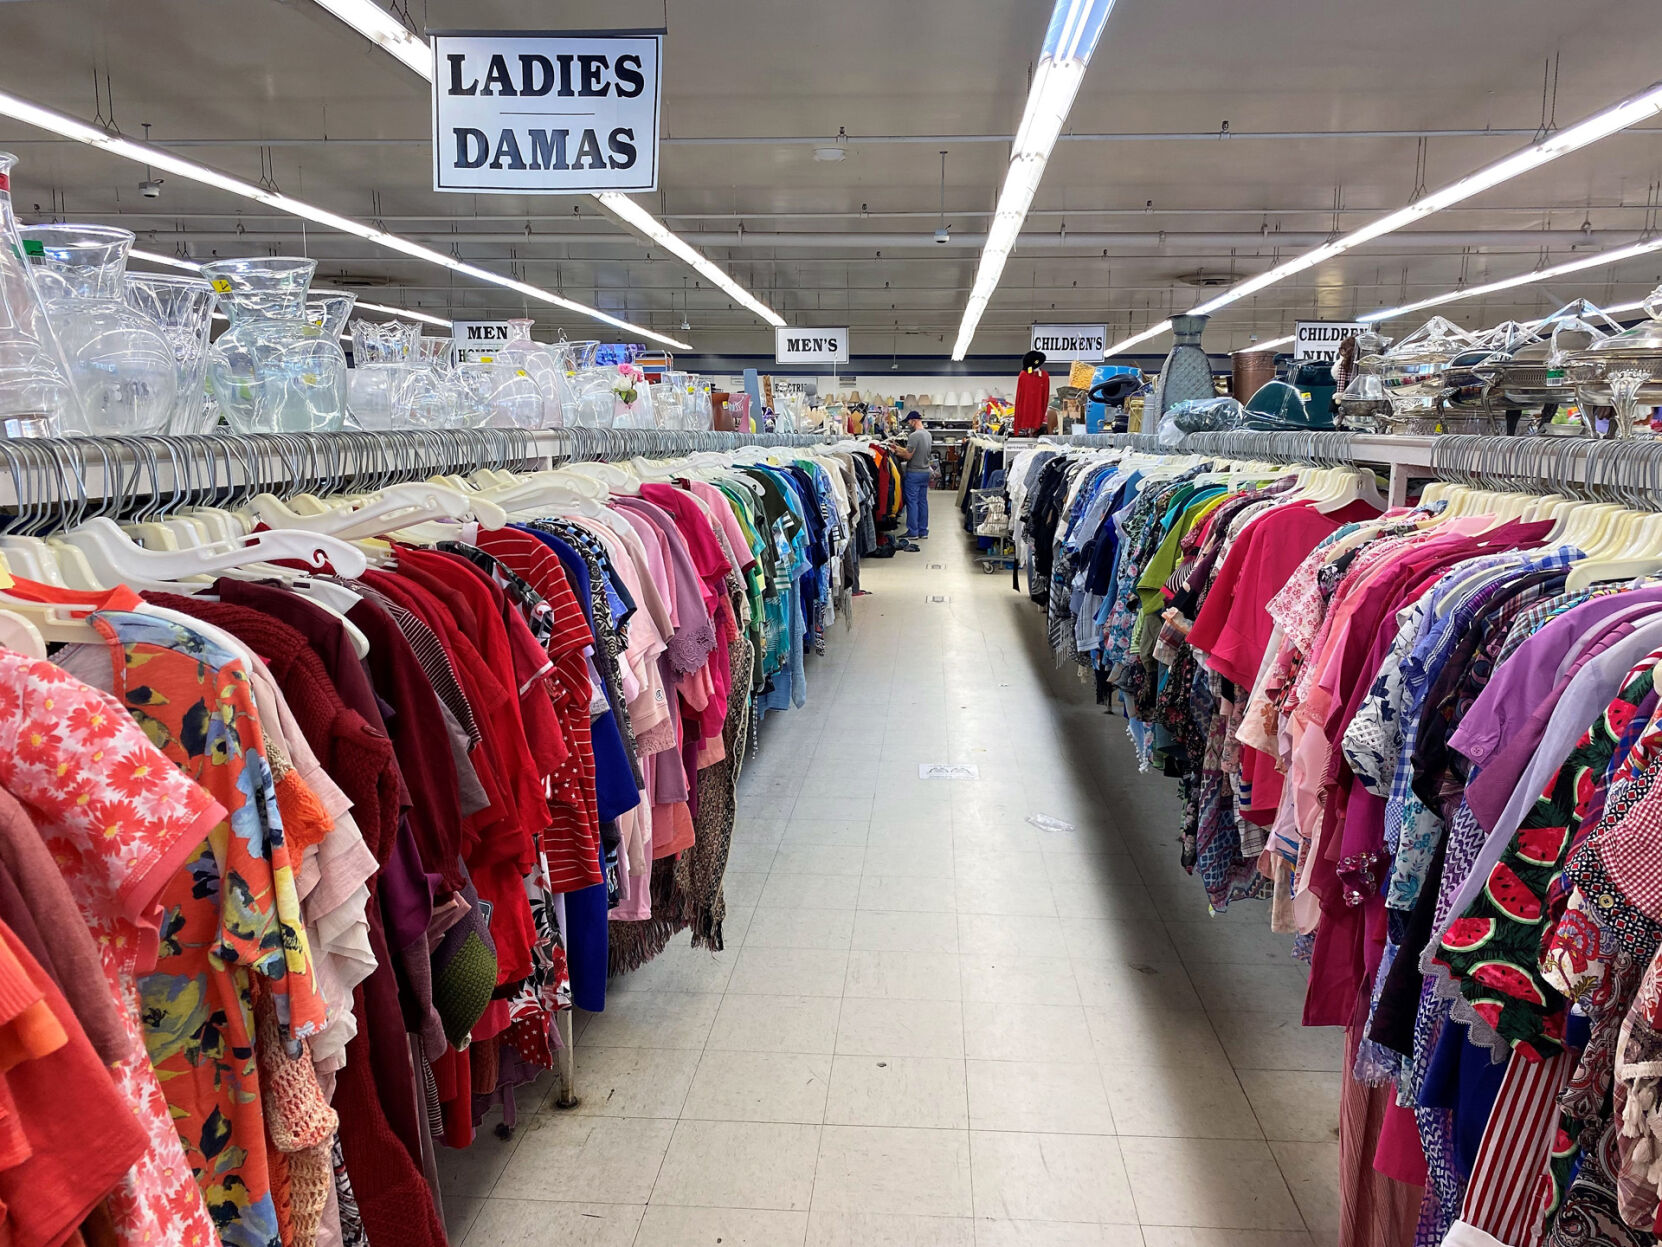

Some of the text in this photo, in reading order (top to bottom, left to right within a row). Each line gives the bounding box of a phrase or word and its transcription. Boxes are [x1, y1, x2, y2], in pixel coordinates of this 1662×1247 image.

[447, 54, 644, 98] LADIES
[453, 127, 637, 170] DAMAS
[467, 326, 508, 340] MEN
[787, 338, 838, 352] MEN'S
[1034, 336, 1102, 351] CHILDREN'S
